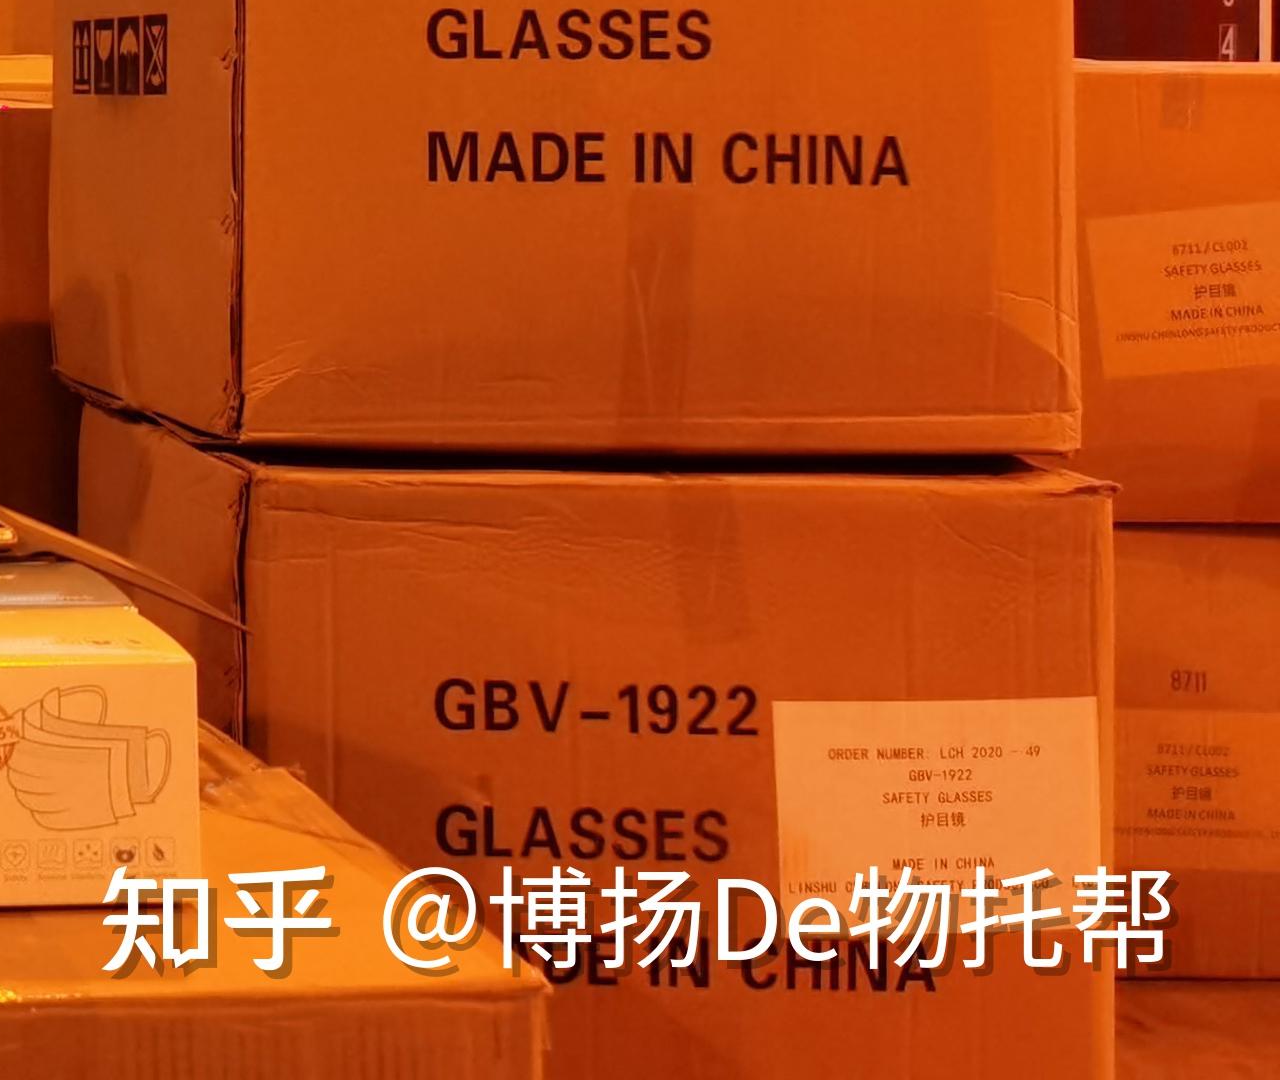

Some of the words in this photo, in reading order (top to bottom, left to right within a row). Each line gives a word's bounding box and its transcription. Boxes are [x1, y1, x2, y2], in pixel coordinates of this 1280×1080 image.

[426, 8, 712, 62] GLASSES
[426, 131, 606, 183] MADE
[633, 132, 694, 183] IN
[721, 133, 910, 187] CHINA
[1163, 263, 1207, 278] SAFETY
[1209, 260, 1262, 275] GLASSES
[1170, 307, 1206, 320] MADE
[1209, 306, 1223, 318] IN
[1225, 305, 1264, 318] CHINA
[434, 678, 759, 736] GBV-1922
[828, 747, 869, 760] ORDER
[940, 747, 964, 759] LCH
[971, 746, 1003, 759] 2020
[1025, 745, 1041, 757] 49
[908, 768, 973, 782] GBV-1922
[1147, 765, 1187, 777] SAFETY
[1189, 766, 1240, 778] GLASSES
[882, 791, 929, 804] SAFETY
[937, 790, 993, 803] GLASSES
[920, 812, 967, 828] 护目镜
[1147, 808, 1184, 819] MADE
[1198, 809, 1236, 820] CHINA
[435, 804, 730, 862] GLASSES
[892, 858, 925, 870] MADE
[934, 857, 948, 869] IN
[955, 856, 995, 869] CHINA
[788, 880, 837, 893] LINSHU
[740, 937, 936, 994] CHINA
